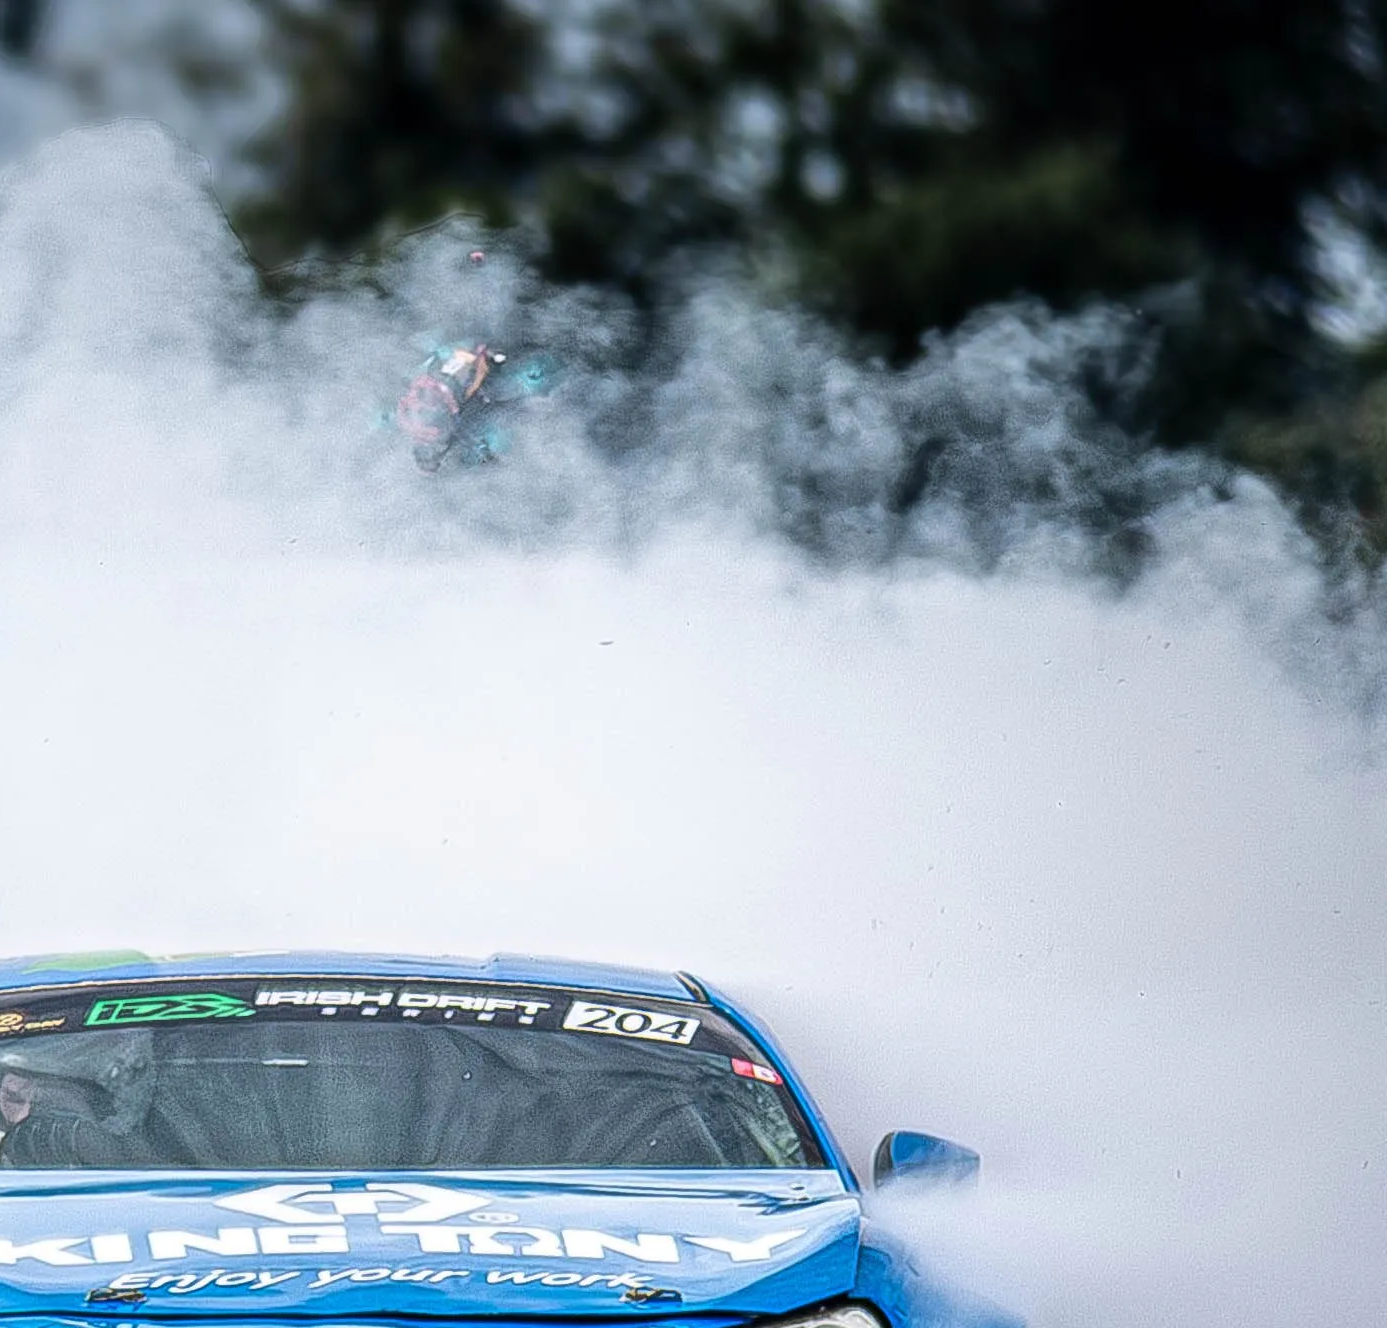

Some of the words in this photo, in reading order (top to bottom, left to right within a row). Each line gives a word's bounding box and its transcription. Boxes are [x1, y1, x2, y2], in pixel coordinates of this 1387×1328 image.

[254, 991, 394, 1006] IRISH
[396, 993, 552, 1014] DRIFT
[580, 1007, 687, 1040] 204
[381, 1225, 808, 1264] TONY
[109, 1269, 300, 1294] Enjoy
[307, 1268, 470, 1290] your
[485, 1267, 654, 1289] work
